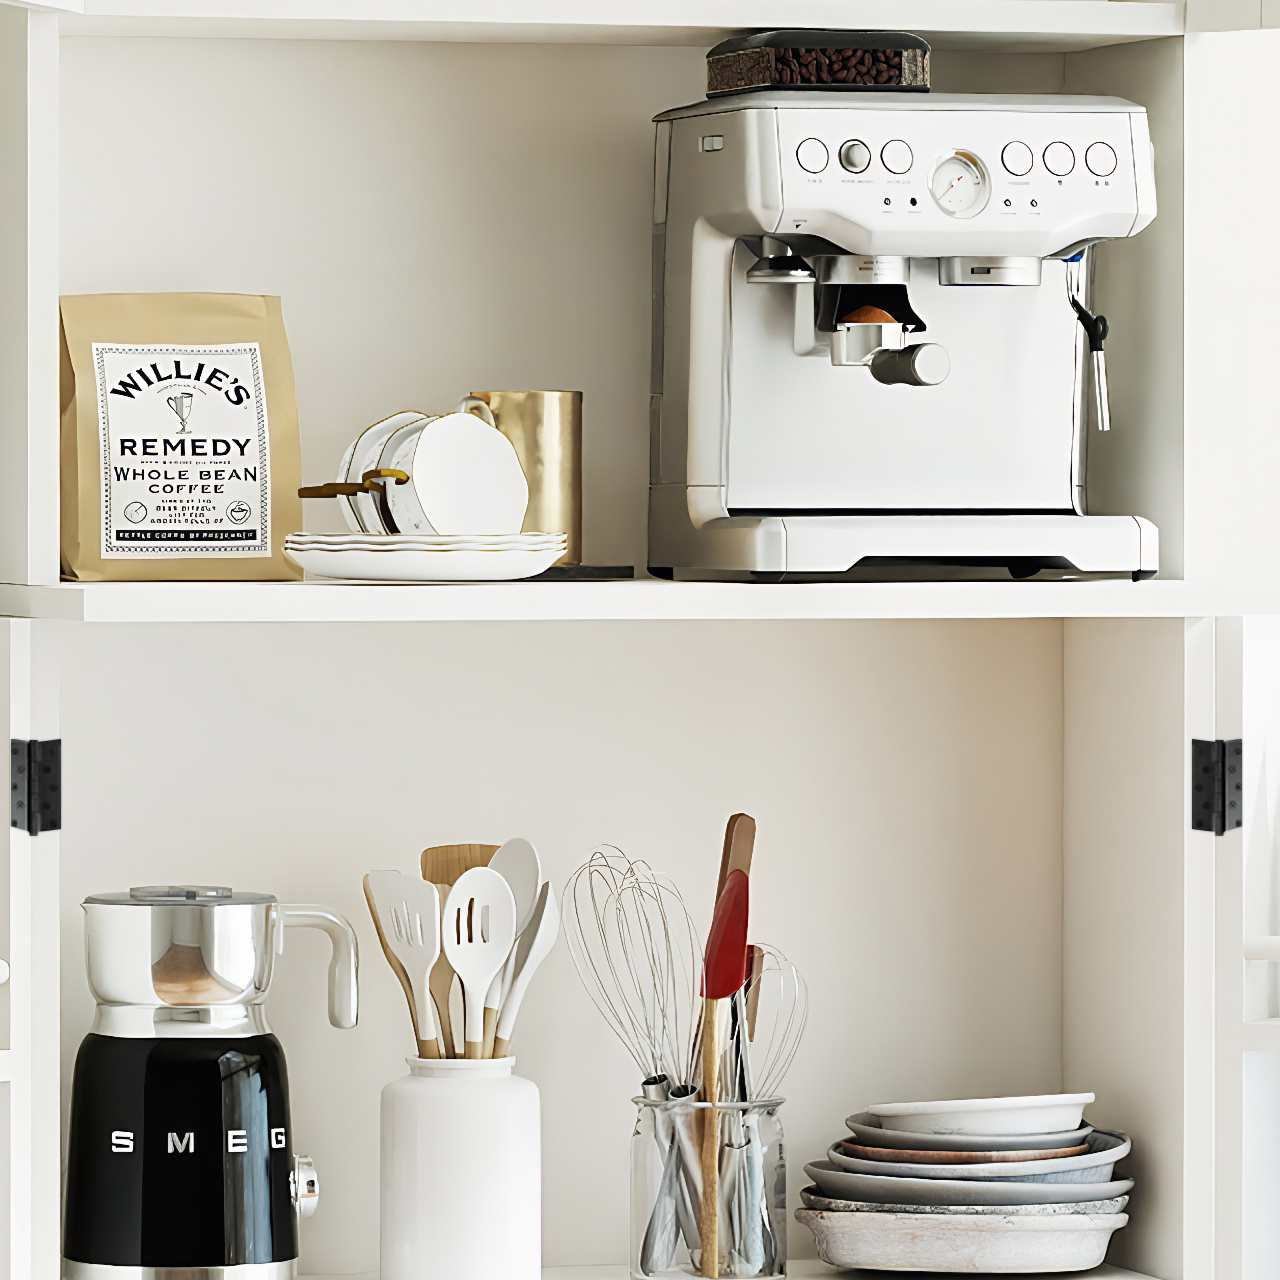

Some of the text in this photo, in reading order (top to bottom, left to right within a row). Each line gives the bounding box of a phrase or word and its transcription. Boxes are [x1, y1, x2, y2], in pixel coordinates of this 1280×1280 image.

[109, 360, 251, 406] WILLIE'S
[119, 438, 252, 457] REMEDY
[114, 466, 257, 482] WHOLE BEAN
[148, 484, 225, 494] COFFEE
